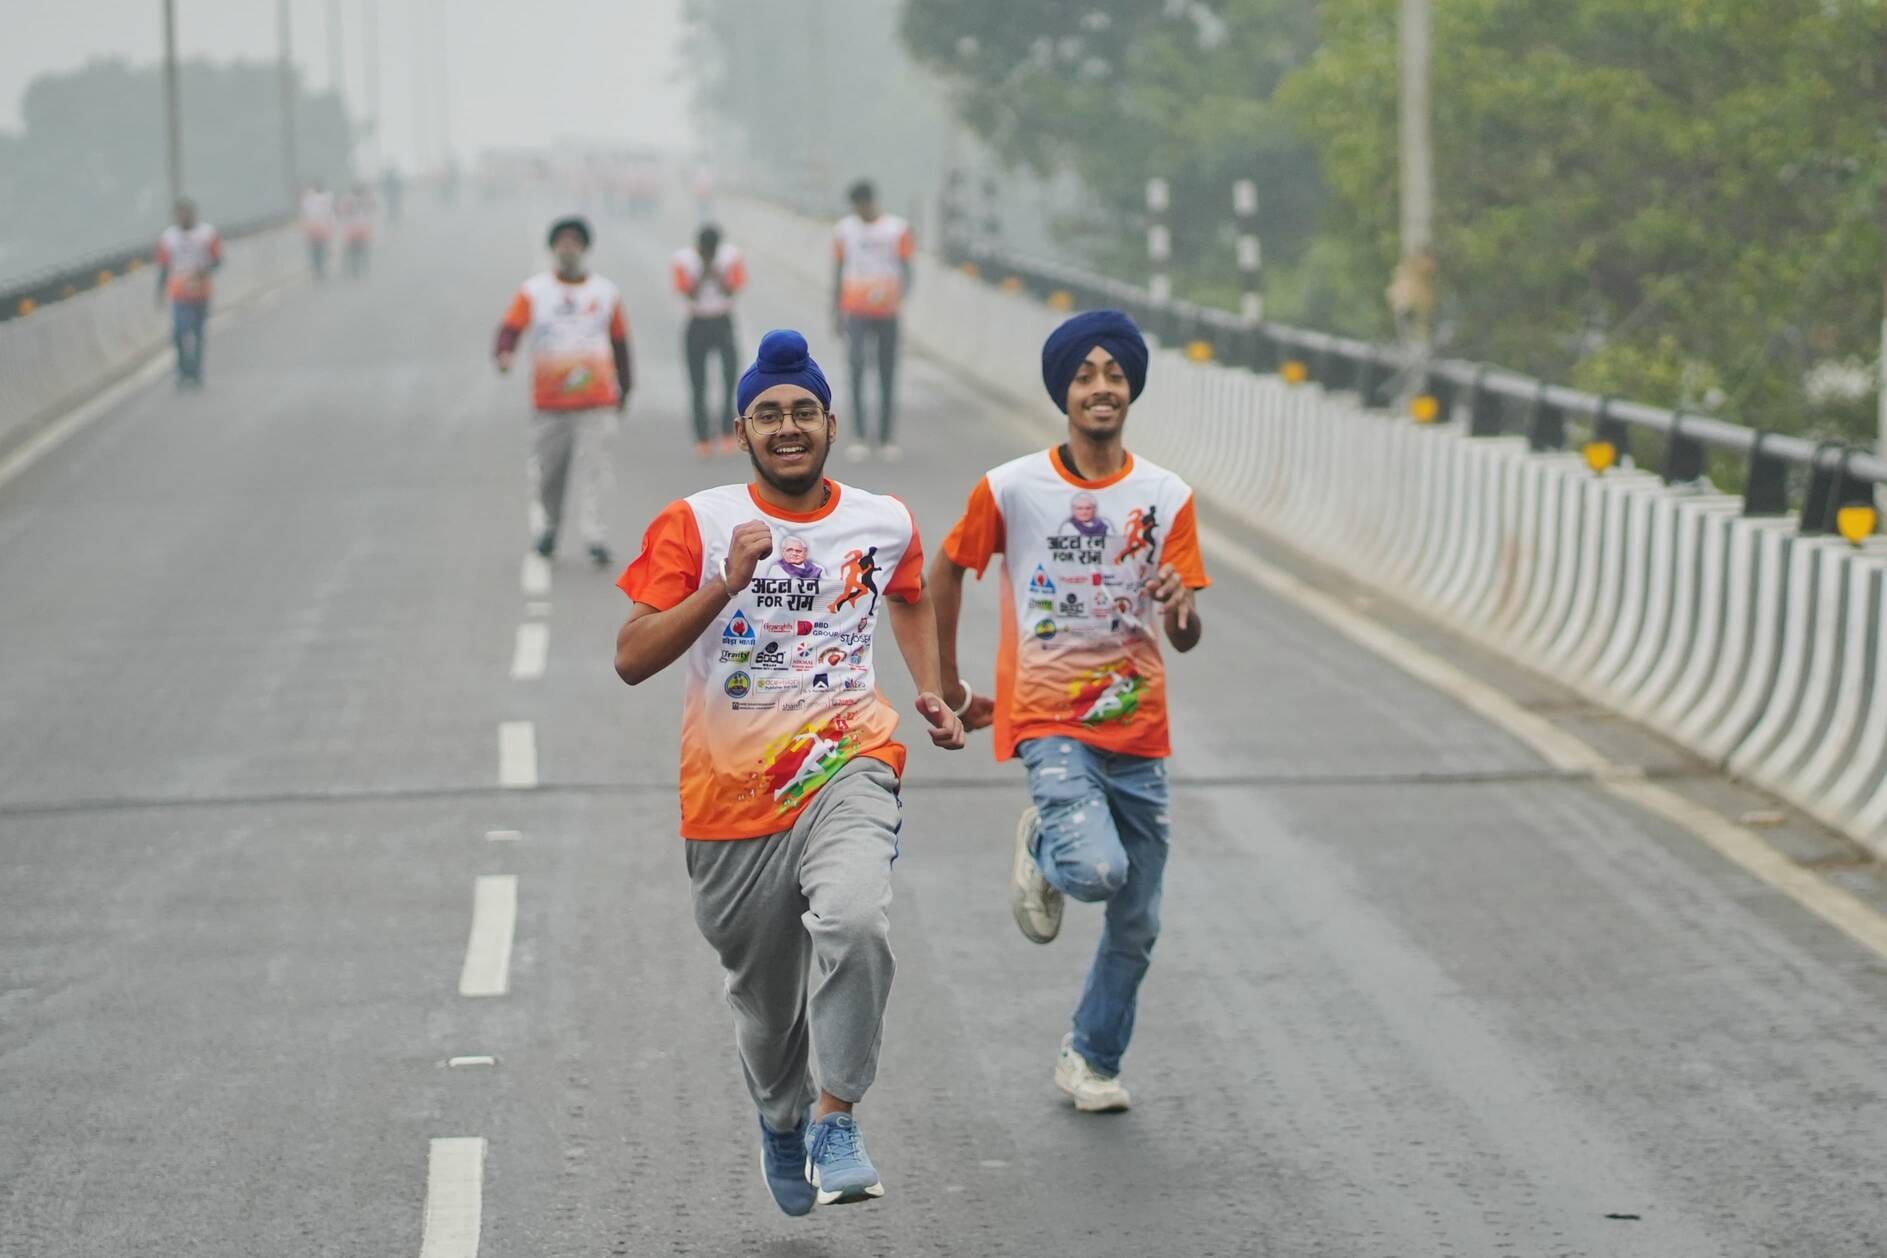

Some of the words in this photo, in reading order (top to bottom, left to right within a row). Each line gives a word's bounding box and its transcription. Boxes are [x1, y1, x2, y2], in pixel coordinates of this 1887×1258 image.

[1053, 551, 1075, 562] FOR
[751, 578, 792, 594] अटल
[797, 578, 820, 595] रन
[757, 595, 783, 607] FOR
[786, 595, 816, 611] राम
[812, 630, 839, 638] GROUP
